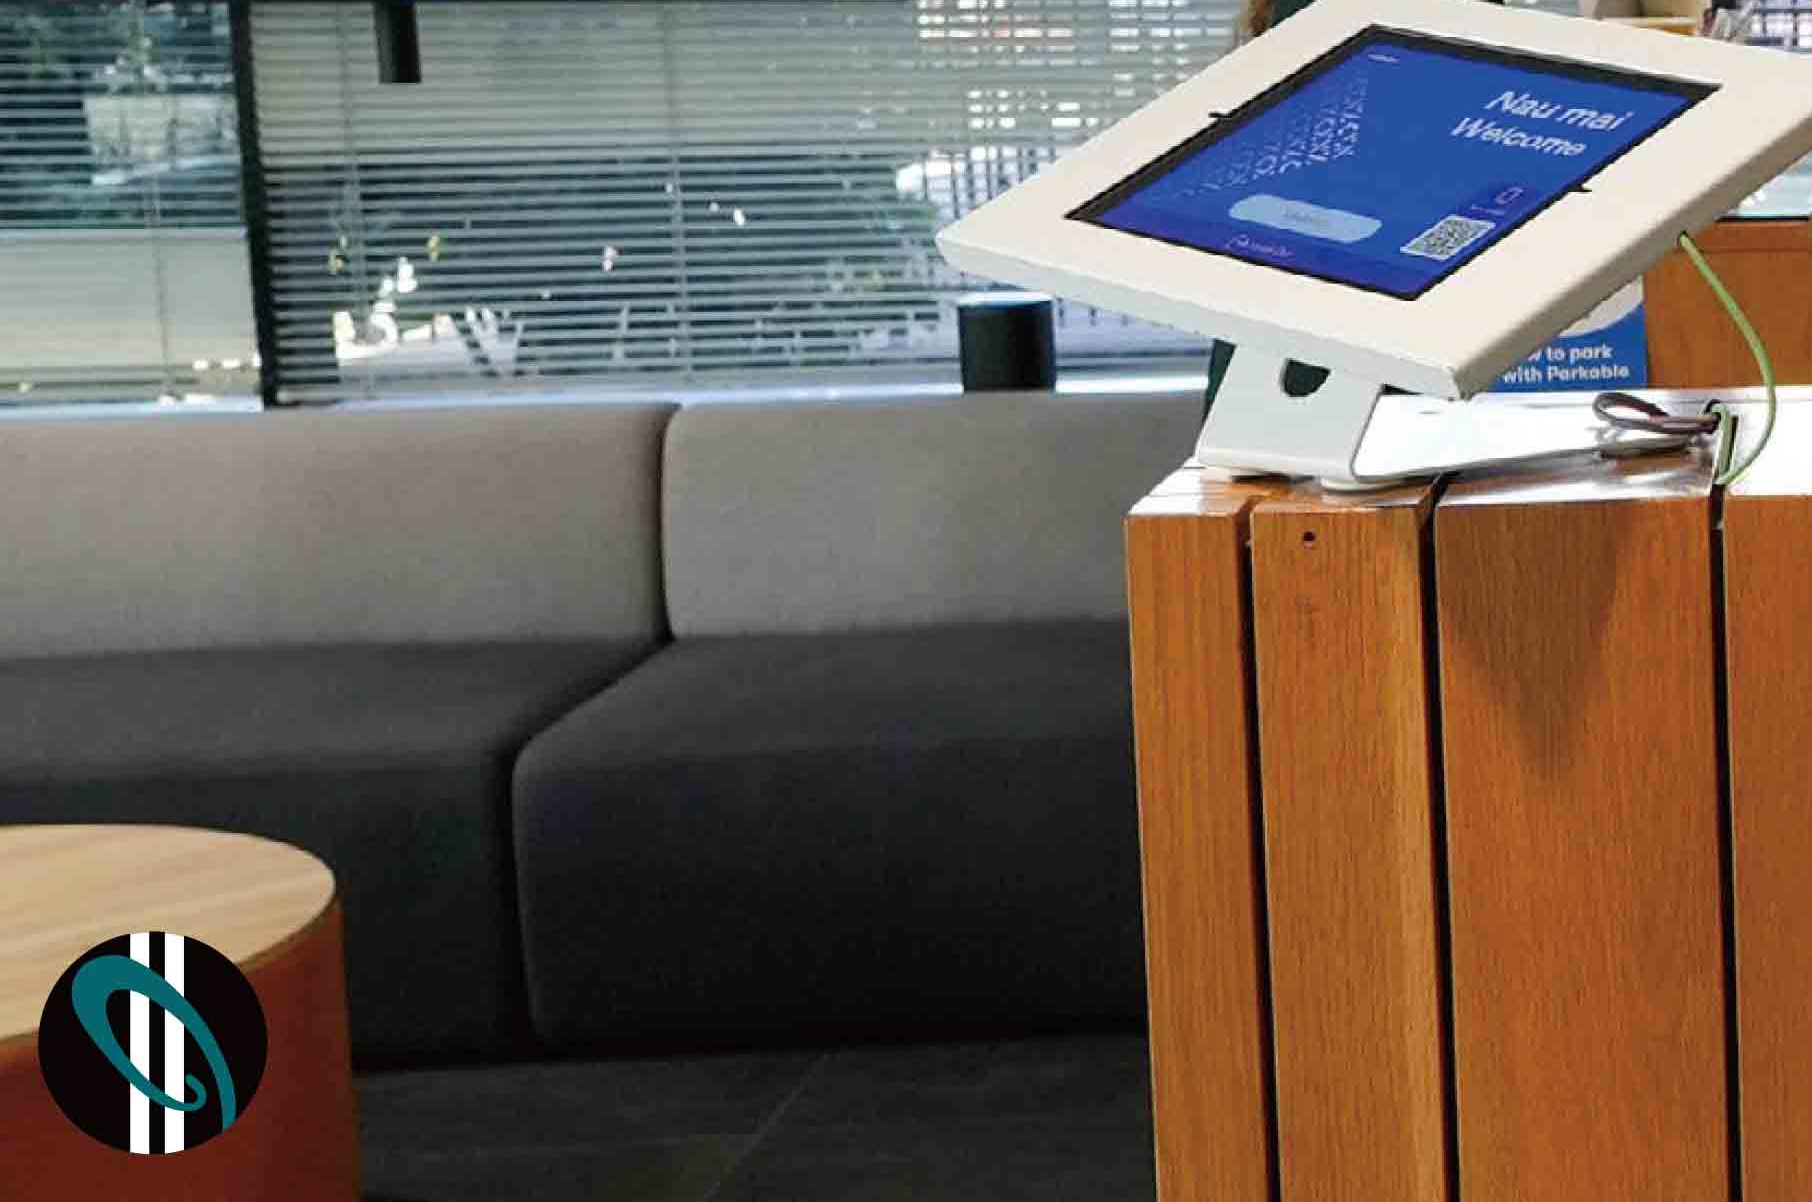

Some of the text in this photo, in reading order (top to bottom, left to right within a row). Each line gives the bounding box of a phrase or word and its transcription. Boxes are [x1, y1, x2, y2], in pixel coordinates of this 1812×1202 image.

[1484, 91, 1635, 131] Nau mai
[1450, 117, 1587, 156] Welcome
[1546, 346, 1566, 361] to
[1569, 343, 1614, 365] park
[1503, 364, 1630, 383] with Parkable
